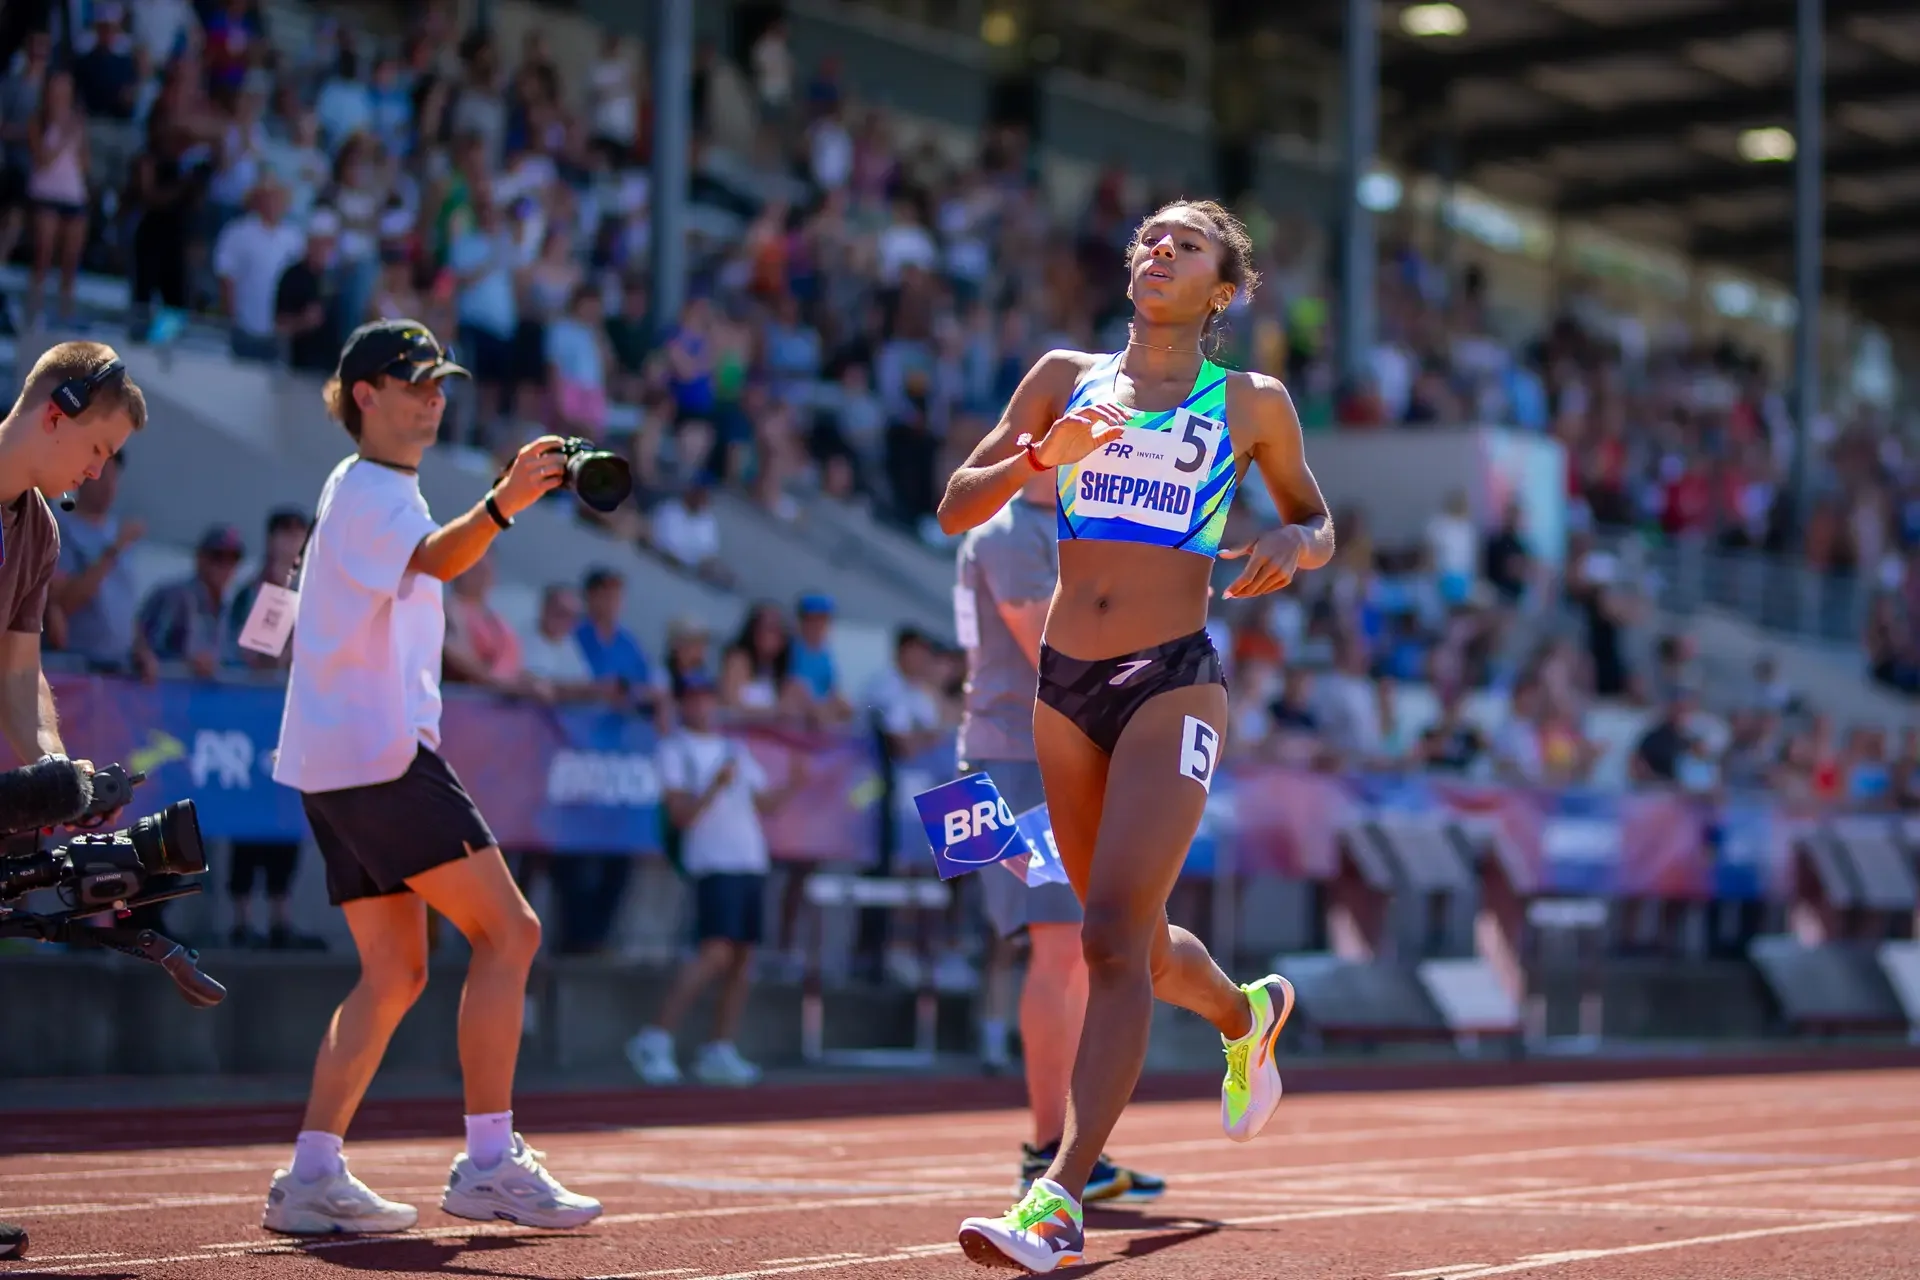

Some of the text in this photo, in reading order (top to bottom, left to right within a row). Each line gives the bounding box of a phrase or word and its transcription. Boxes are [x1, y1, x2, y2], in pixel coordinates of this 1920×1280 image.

[1104, 443, 1165, 461] PR INVITAT
[1174, 415, 1213, 473] 5
[1080, 470, 1191, 515] SHEPPARD
[192, 729, 254, 790] PR
[1191, 723, 1214, 781] 5
